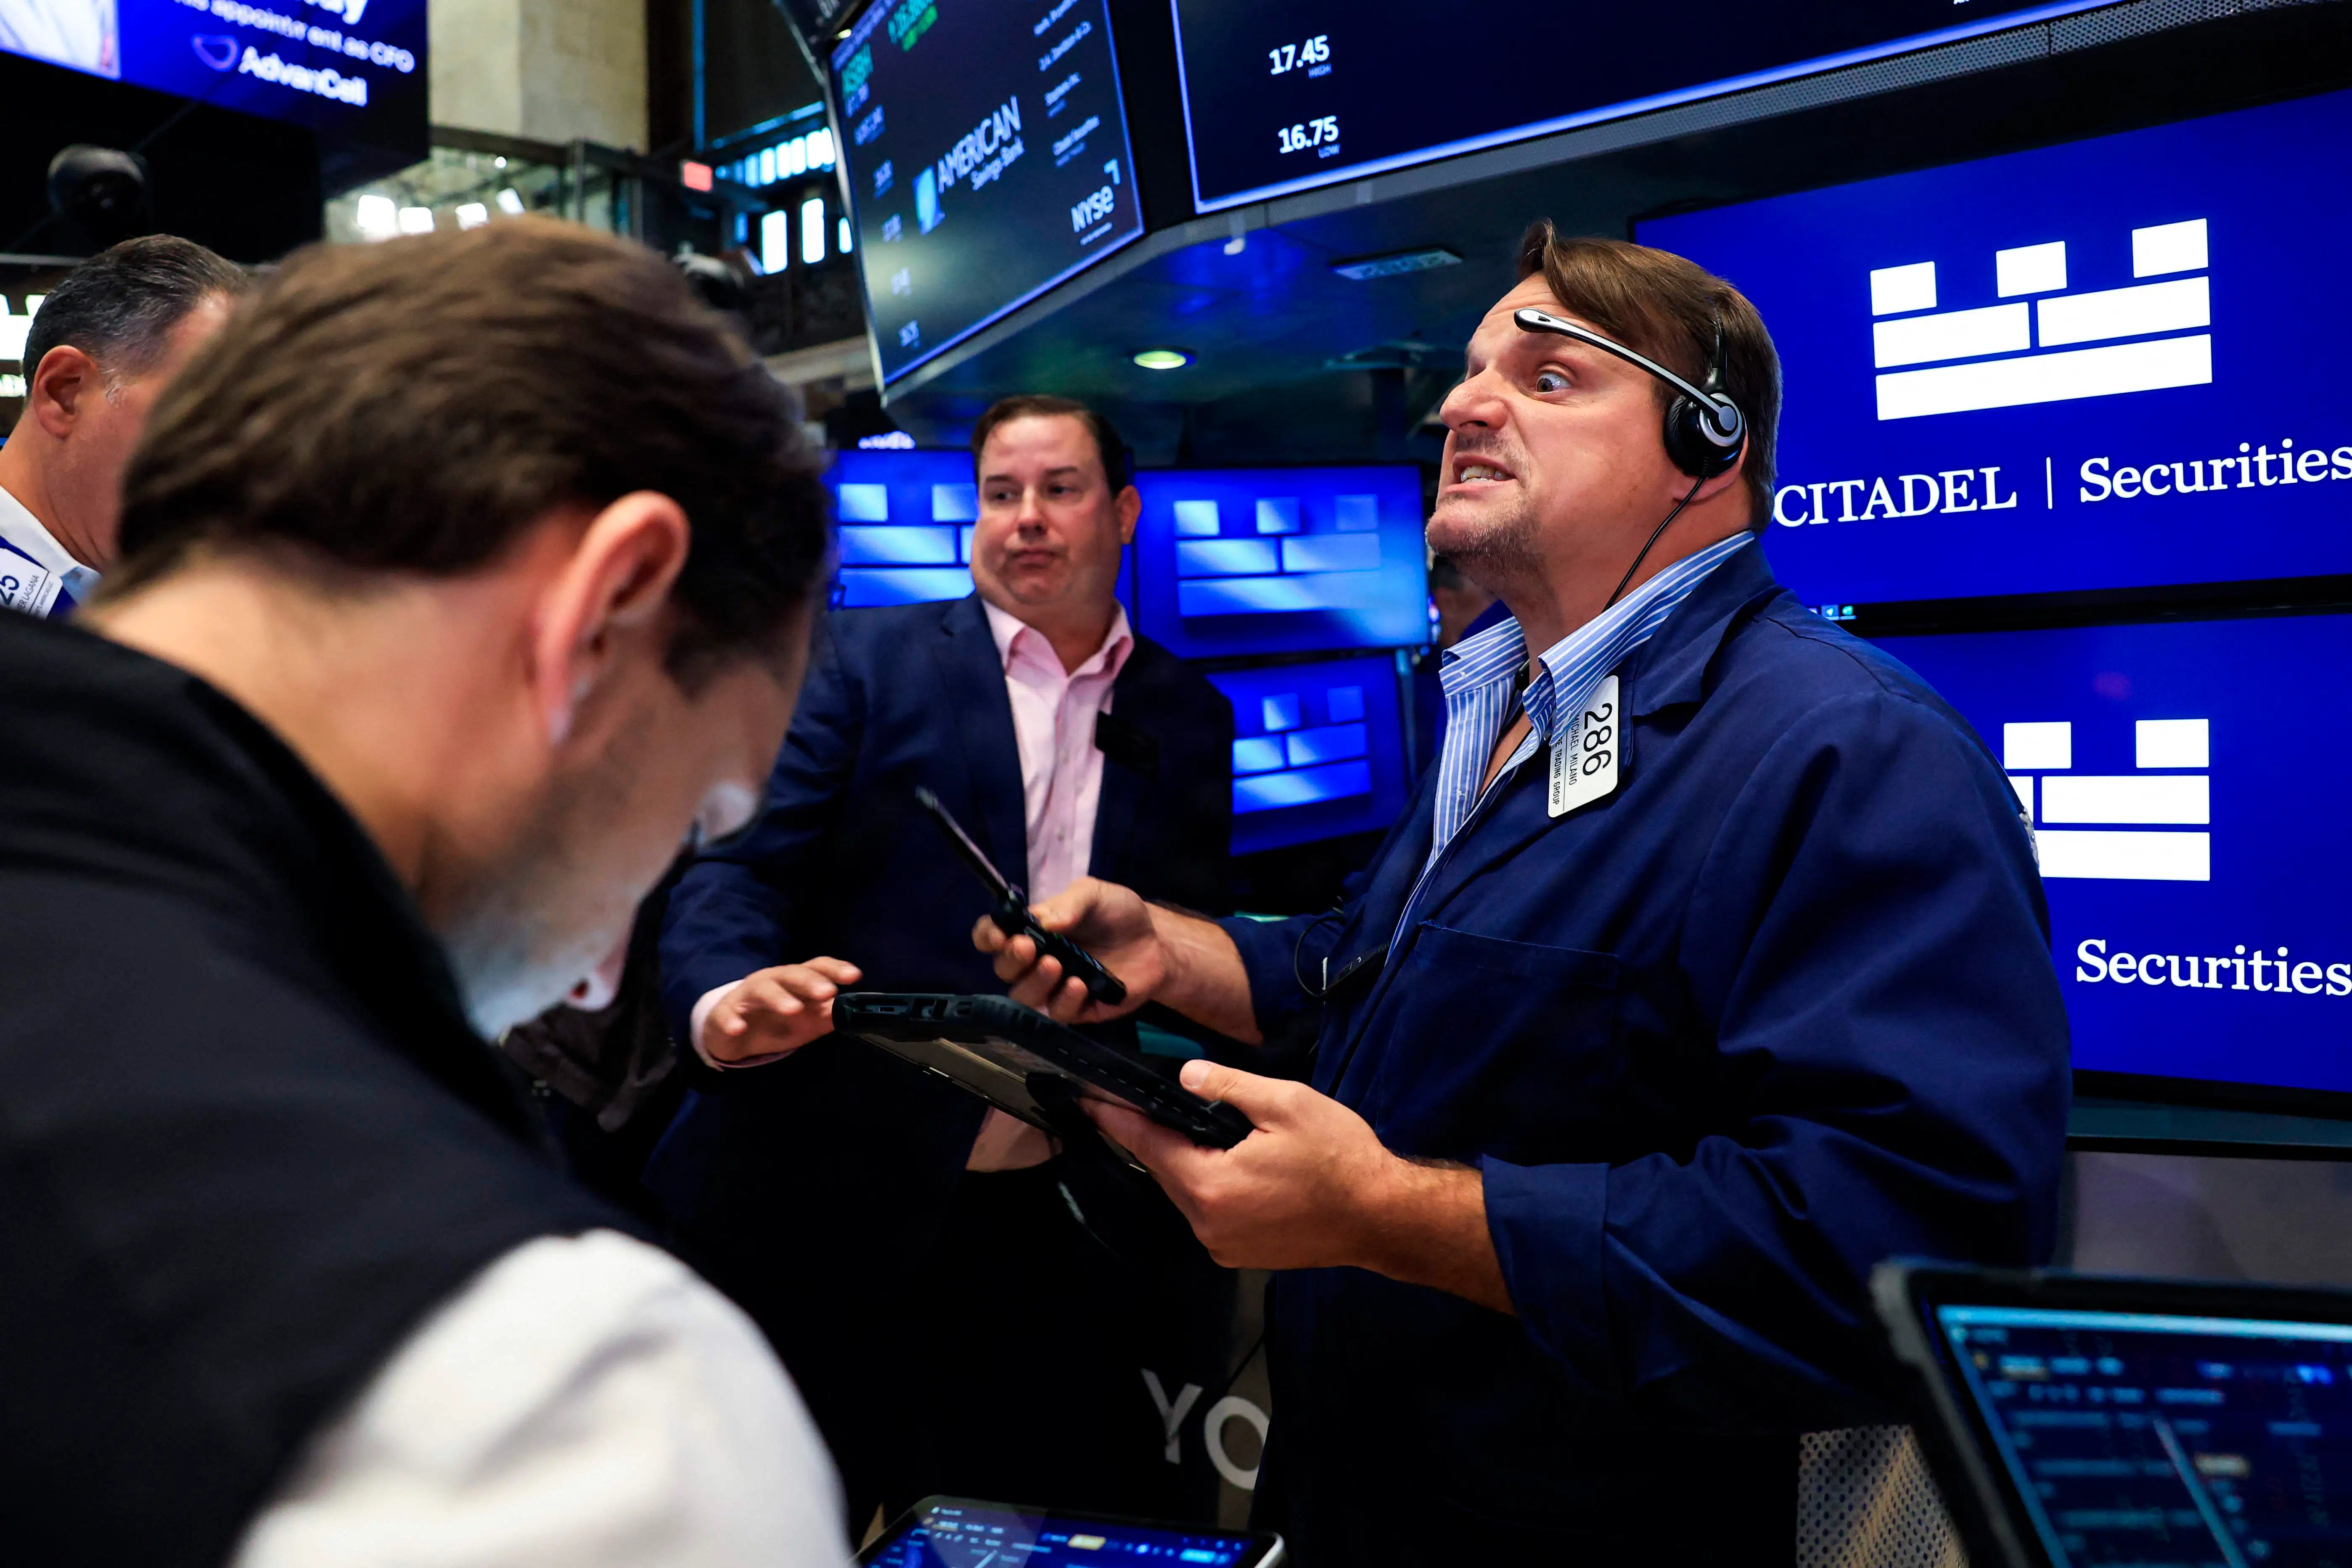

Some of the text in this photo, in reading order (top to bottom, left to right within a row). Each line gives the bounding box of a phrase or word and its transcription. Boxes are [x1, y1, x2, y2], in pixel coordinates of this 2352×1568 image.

[370, 42, 415, 73] CFO
[1269, 35, 1330, 75] 17.45
[937, 95, 1021, 193] AMERICAN
[1278, 115, 1339, 153] 16.75
[970, 156, 1003, 190] Savings
[1000, 135, 1025, 167] Bank
[1773, 438, 2352, 527] CITADEL Securities
[22, 575, 40, 600] LAGANA
[1553, 748, 1562, 778] TRADING
[1569, 714, 1580, 785] MICHAEL MILANO
[1583, 703, 1612, 776] 286
[2076, 939, 2352, 996] Securities
